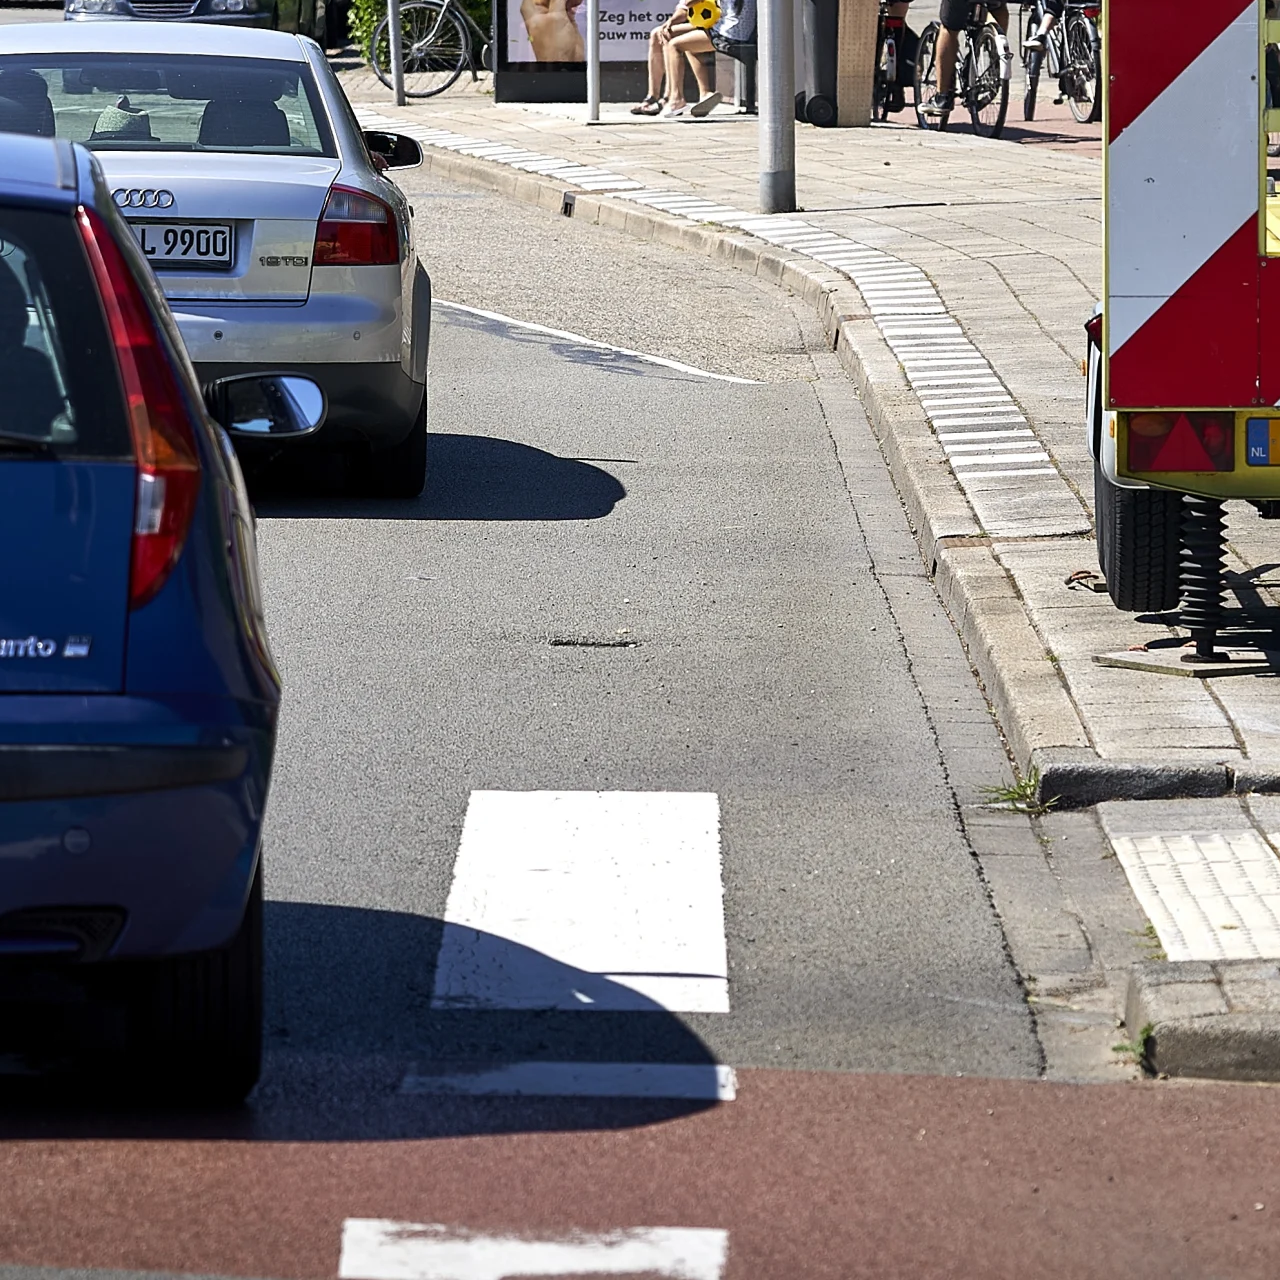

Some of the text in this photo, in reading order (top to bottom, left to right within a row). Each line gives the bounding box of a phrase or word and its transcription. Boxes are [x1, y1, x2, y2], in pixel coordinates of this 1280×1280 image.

[599, 10, 625, 25] Zeg
[629, 10, 652, 22] het
[164, 228, 227, 256] 9900
[1251, 446, 1266, 458] NL
